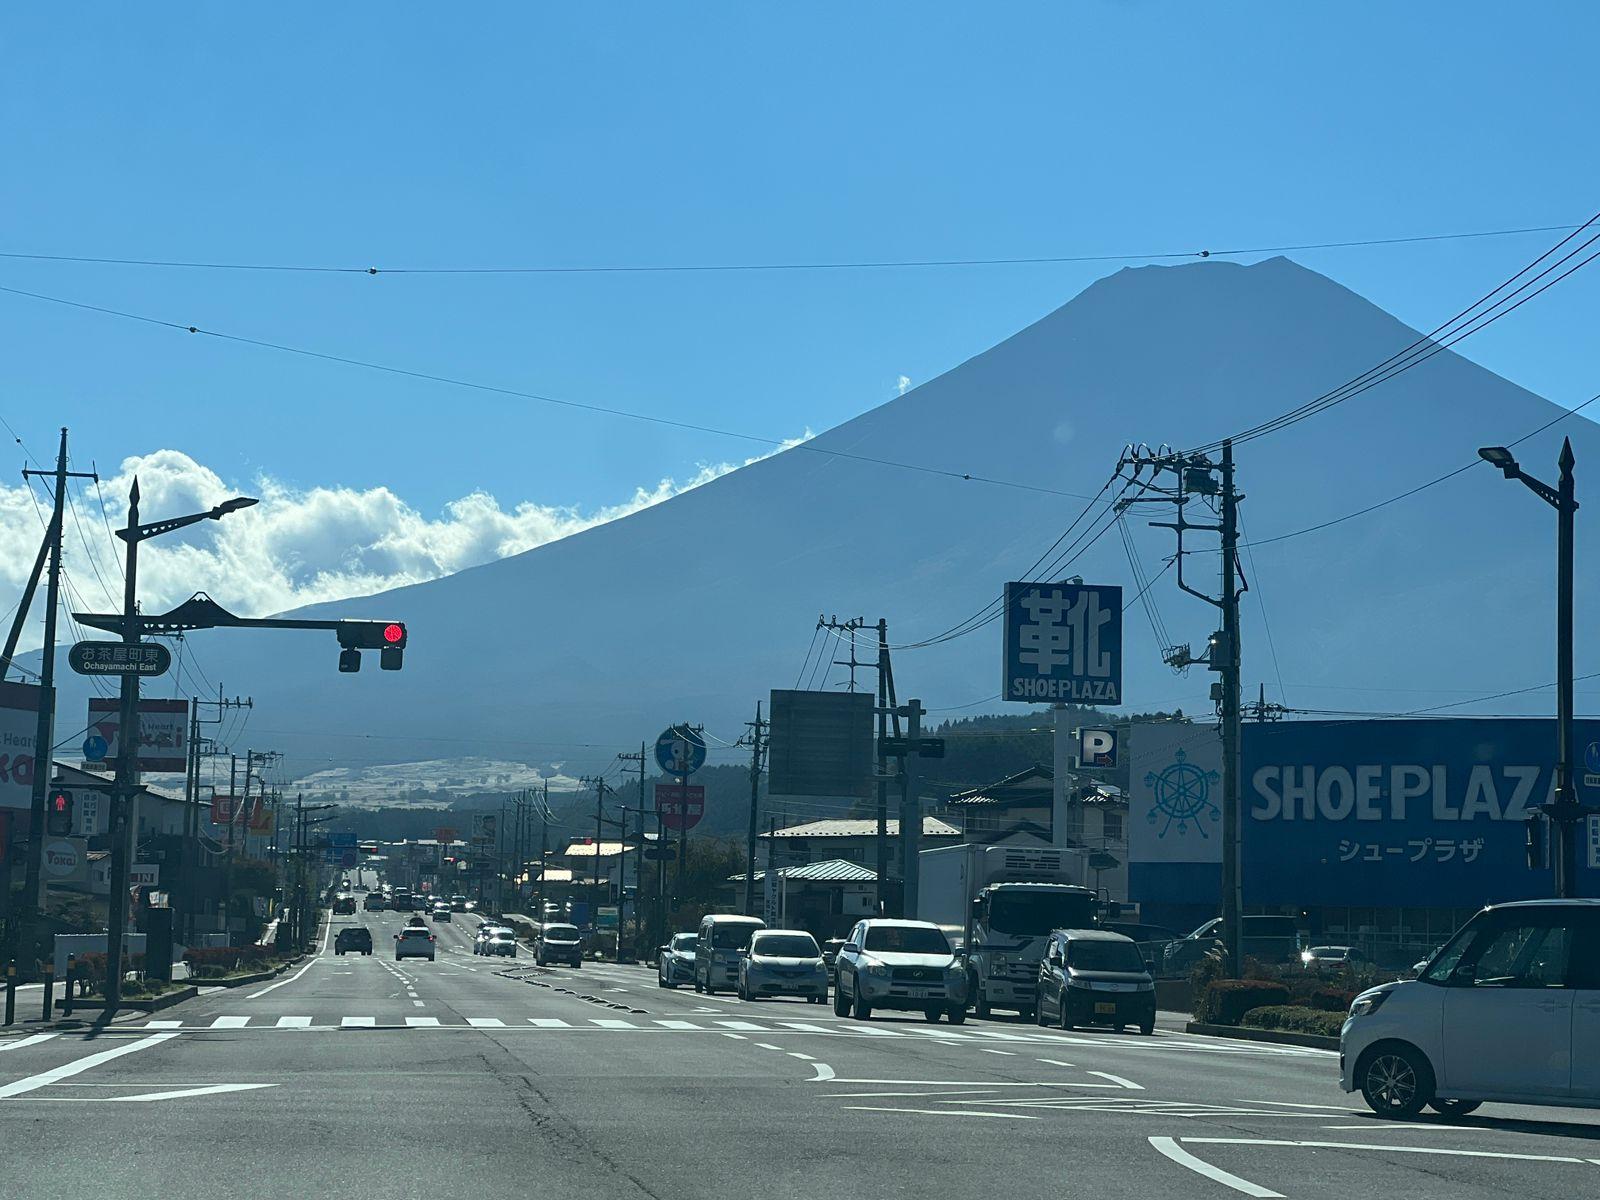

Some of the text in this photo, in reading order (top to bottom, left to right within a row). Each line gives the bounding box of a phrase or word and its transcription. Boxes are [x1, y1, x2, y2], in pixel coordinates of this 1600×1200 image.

[82, 647, 159, 662] お茶屋町東
[84, 662, 157, 671] Ochayamachi East
[1012, 677, 1118, 700] SHOEPLAZA
[1083, 732, 1113, 761] P
[1339, 838, 1485, 863] シュープラザ
